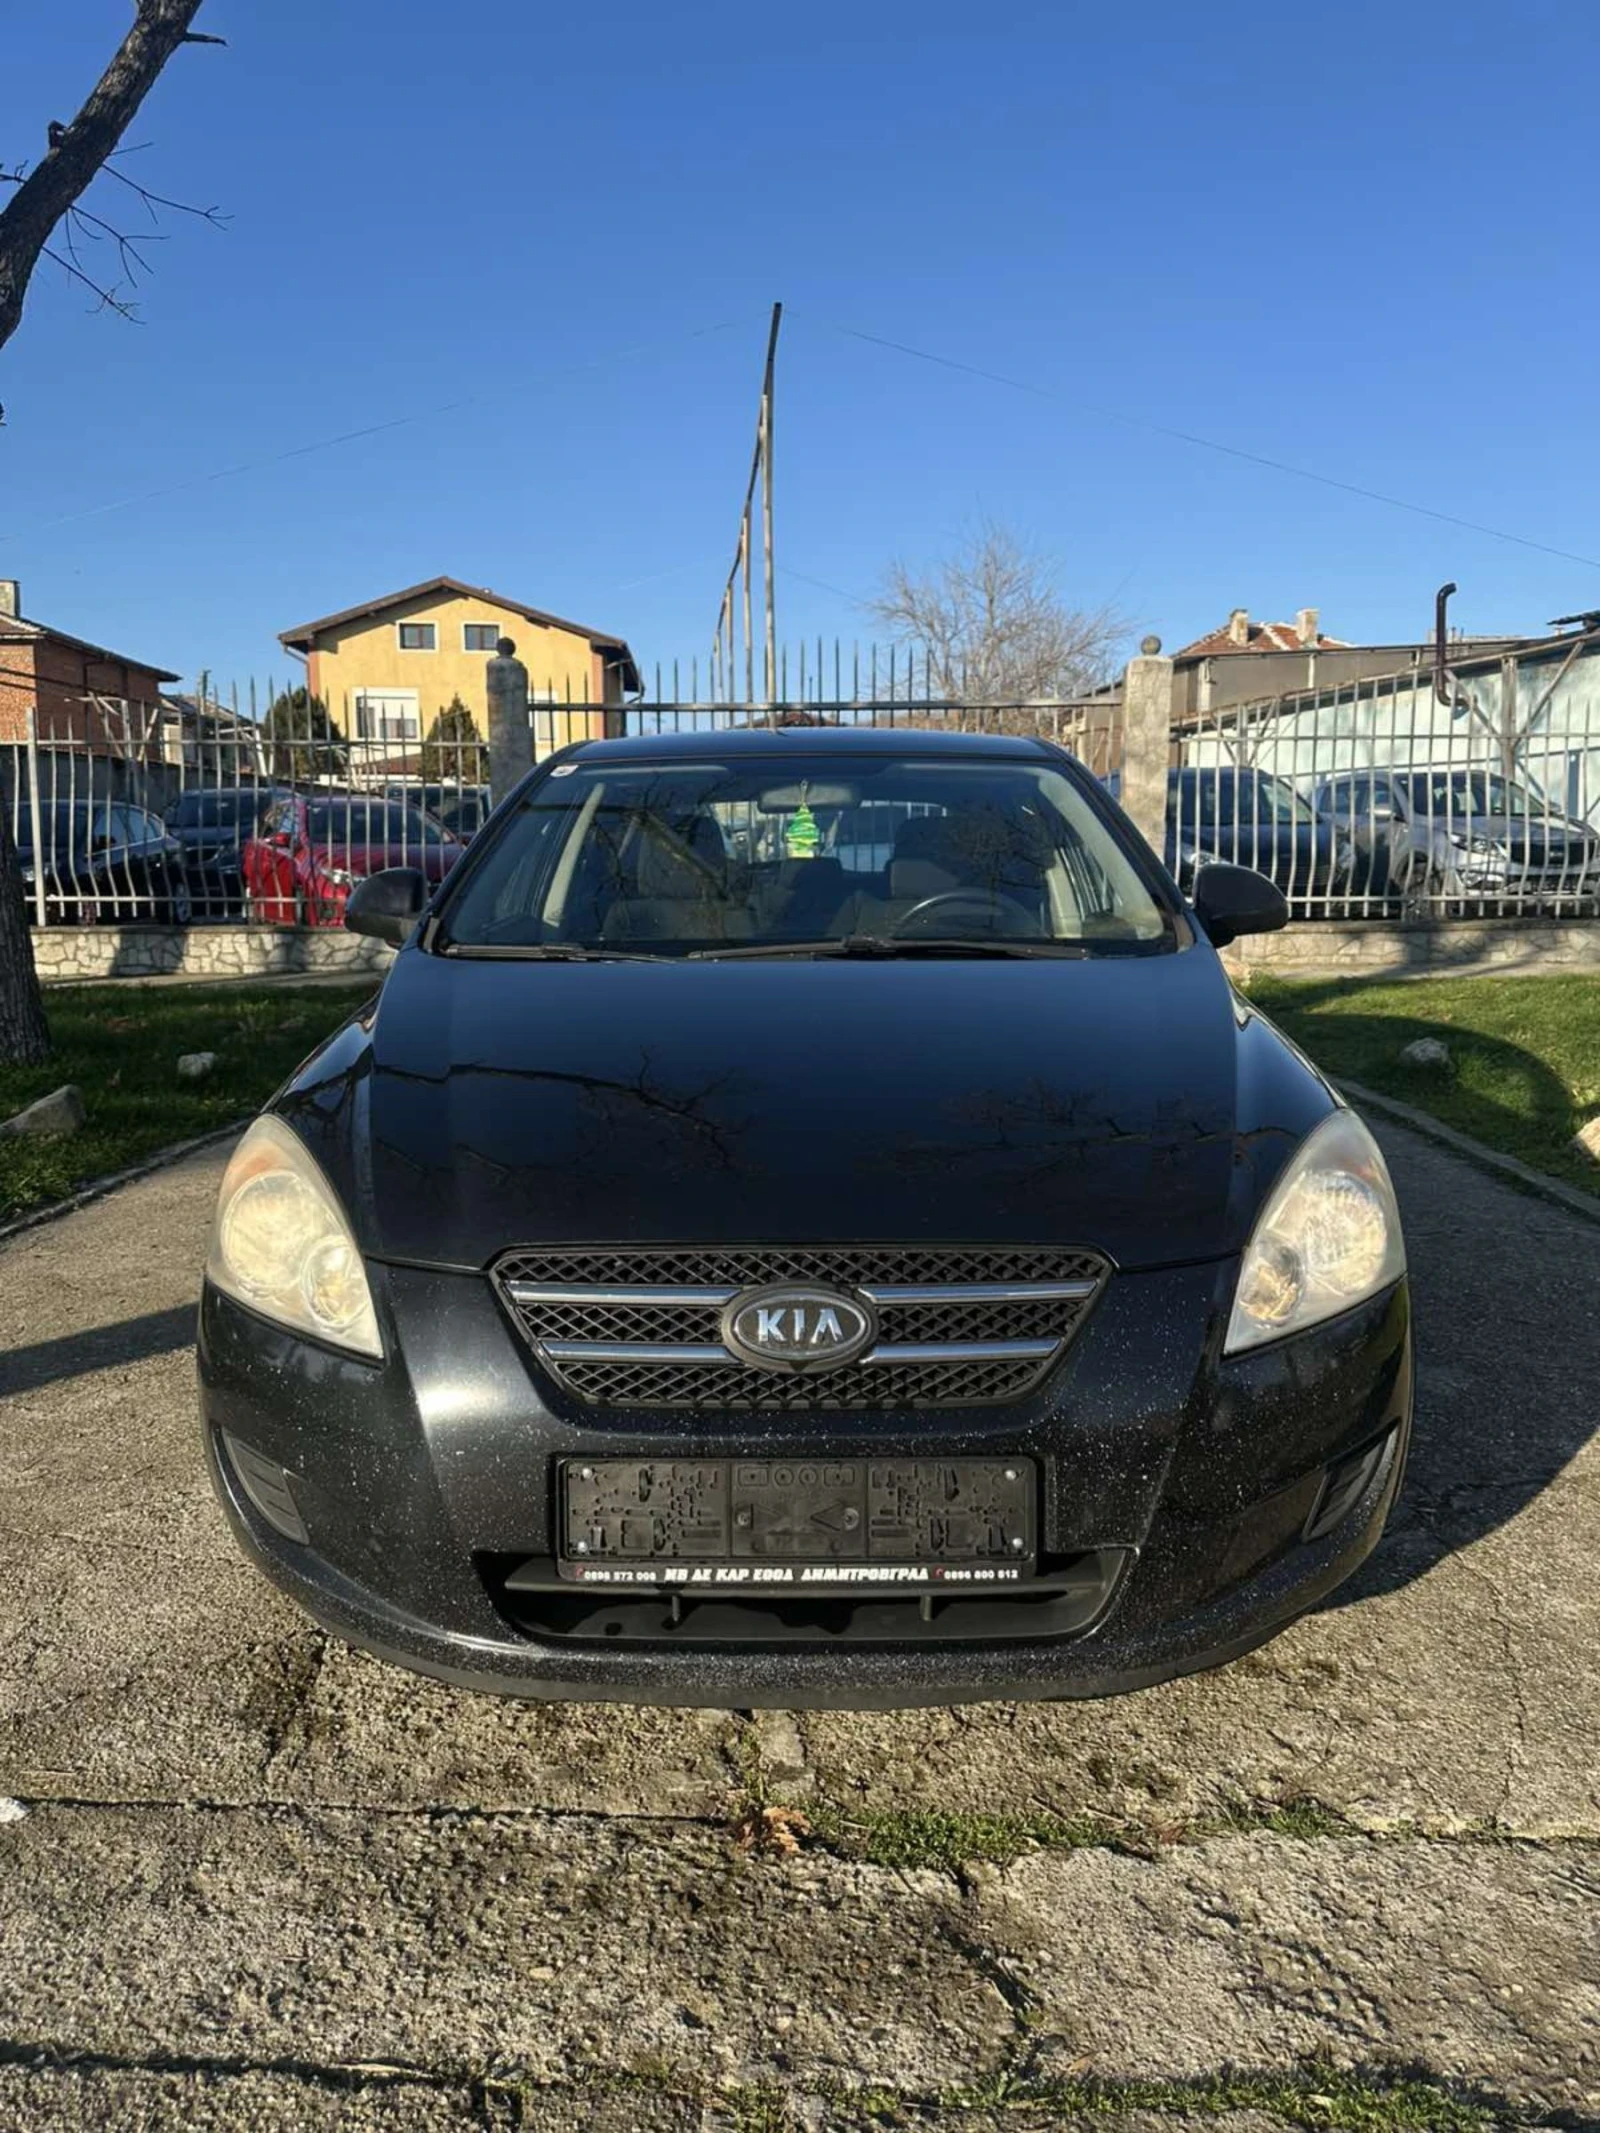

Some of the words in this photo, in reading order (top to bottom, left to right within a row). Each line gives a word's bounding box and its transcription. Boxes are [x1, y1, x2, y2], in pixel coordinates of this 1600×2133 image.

[757, 1308, 844, 1344] KIA
[715, 1567, 749, 1582] КАР
[752, 1567, 794, 1582] ЕООД
[800, 1567, 929, 1582] ДИМИТРОВГРАД
